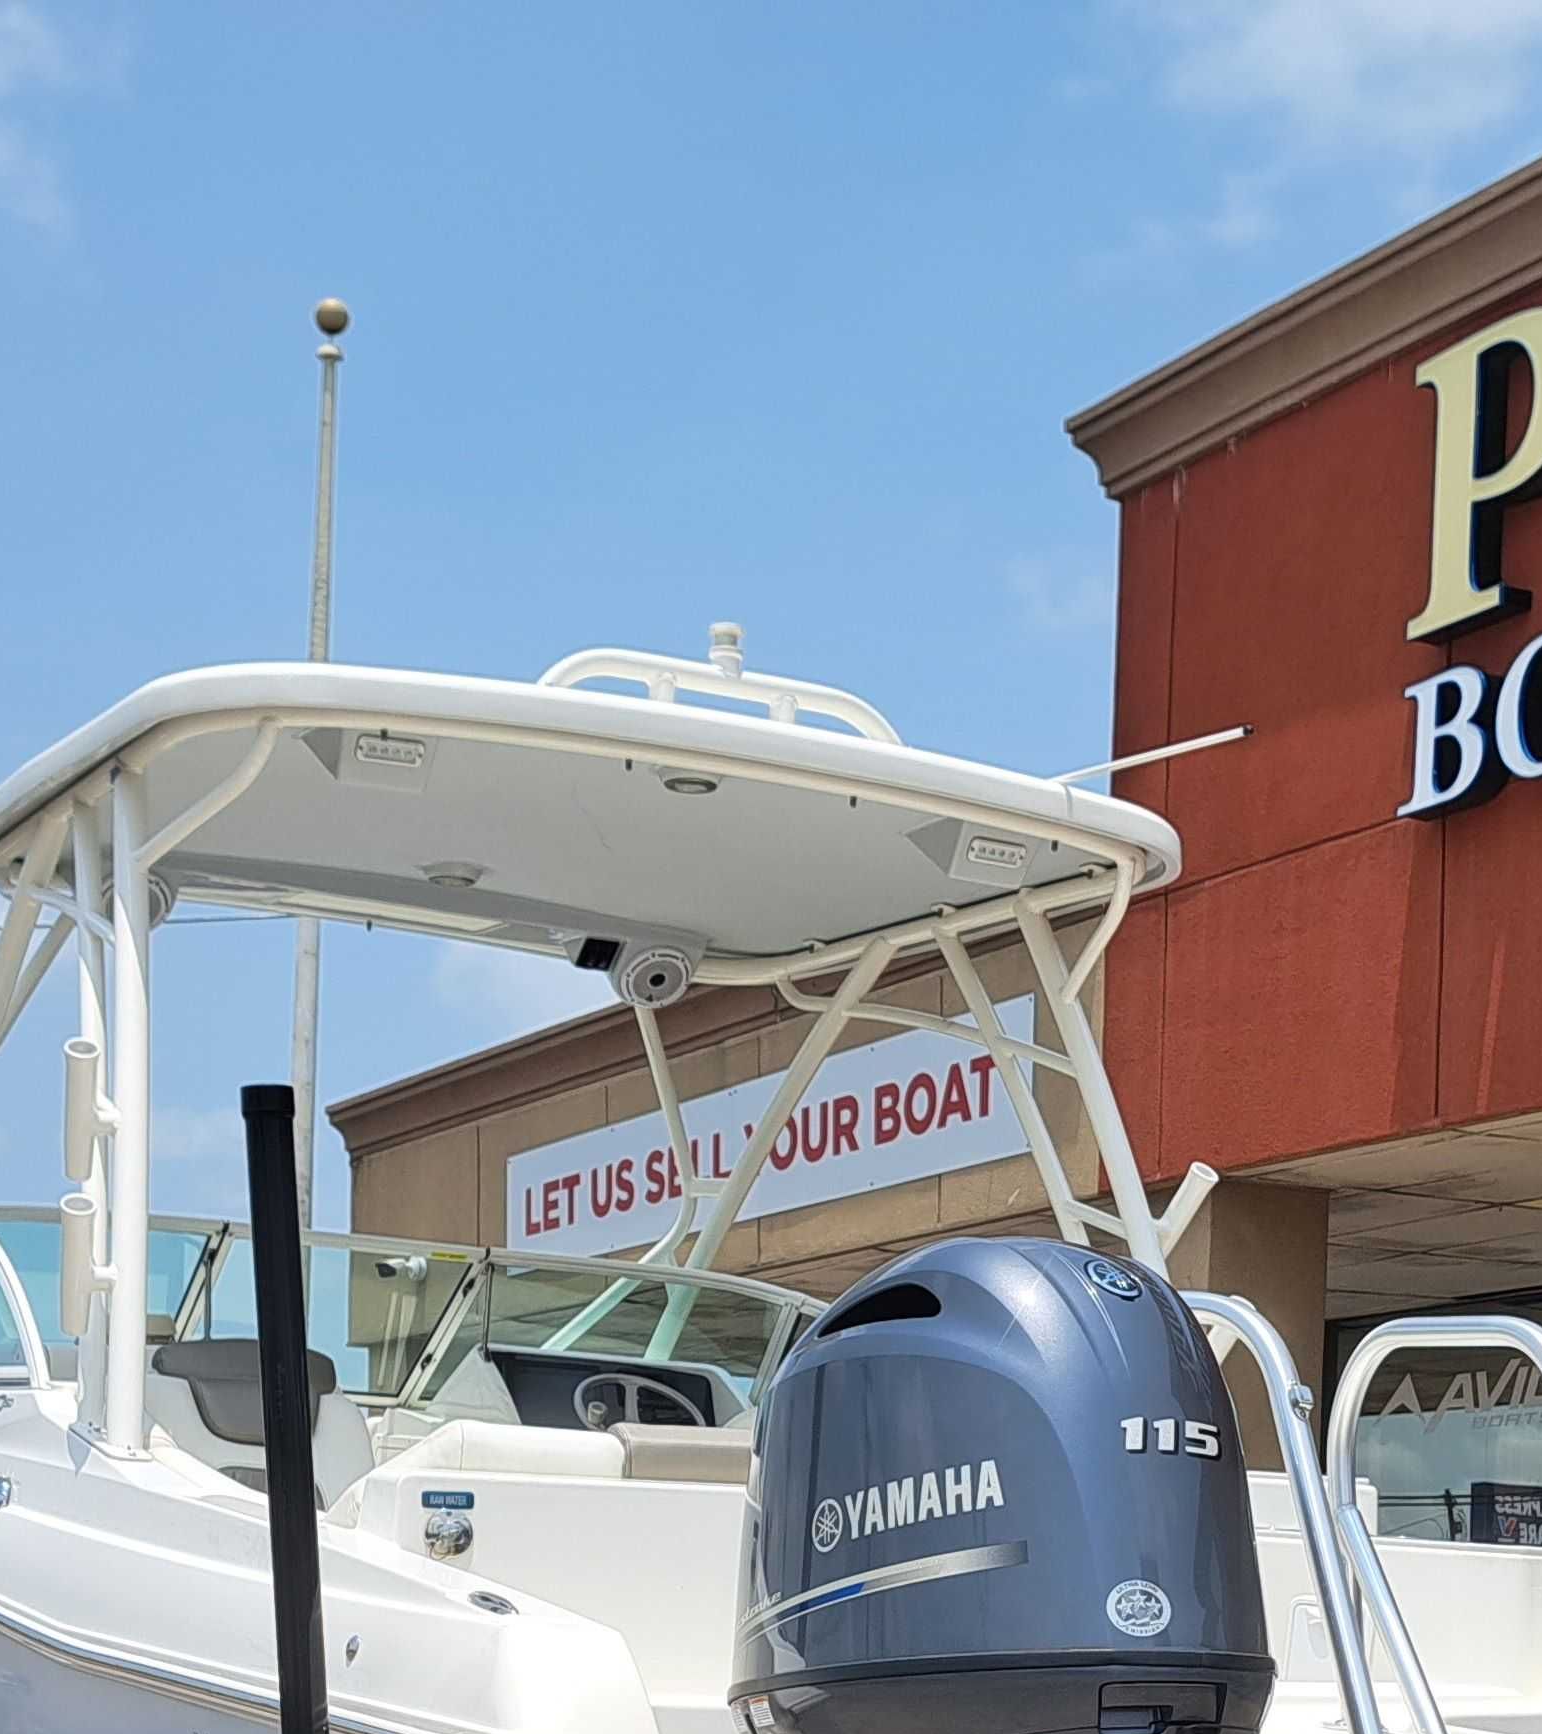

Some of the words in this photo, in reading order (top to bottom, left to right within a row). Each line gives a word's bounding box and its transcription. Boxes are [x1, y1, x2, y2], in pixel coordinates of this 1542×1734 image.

[524, 1172, 582, 1237] LET
[590, 1158, 635, 1219] US
[744, 1094, 861, 1172] OUR
[873, 1054, 999, 1146] BOAT
[1120, 1416, 1222, 1459] 115
[845, 1459, 1005, 1540] YAMAHA
